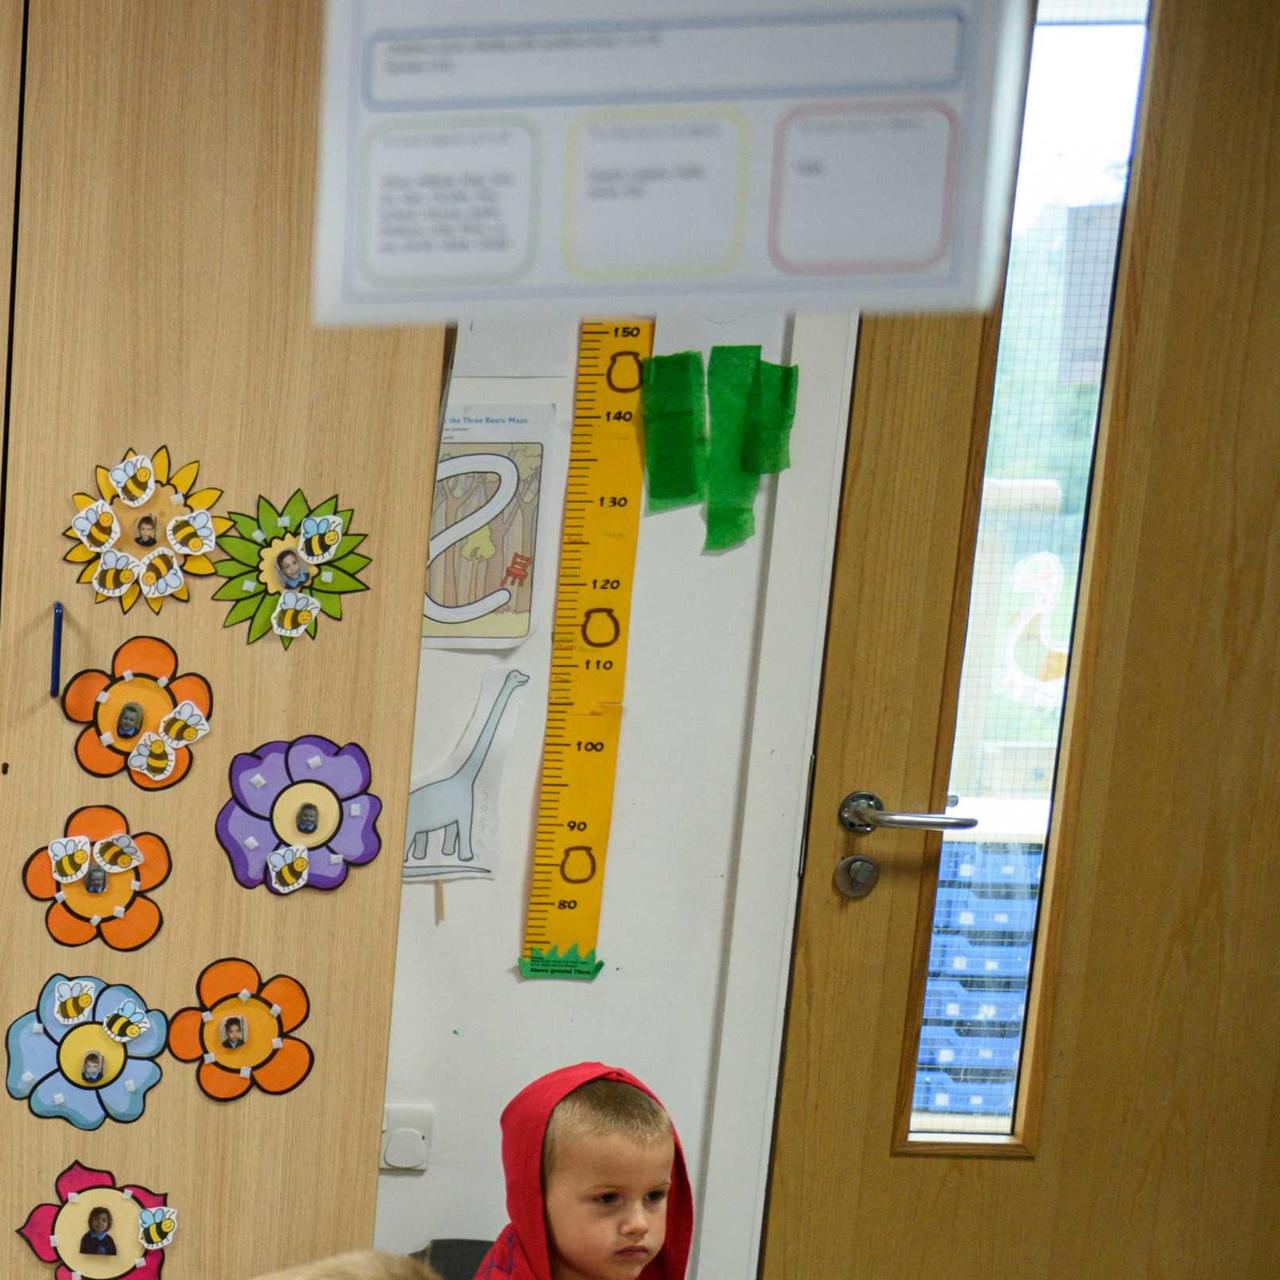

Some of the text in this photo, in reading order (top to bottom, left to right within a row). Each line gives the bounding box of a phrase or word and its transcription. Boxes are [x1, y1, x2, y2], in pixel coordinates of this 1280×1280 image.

[614, 327, 640, 338] 150
[604, 411, 633, 423] 140
[599, 496, 628, 508] 130
[592, 579, 621, 590] 120
[584, 660, 613, 670] 110
[575, 740, 604, 752] 100
[566, 820, 587, 832] 90
[557, 898, 577, 910] 80
